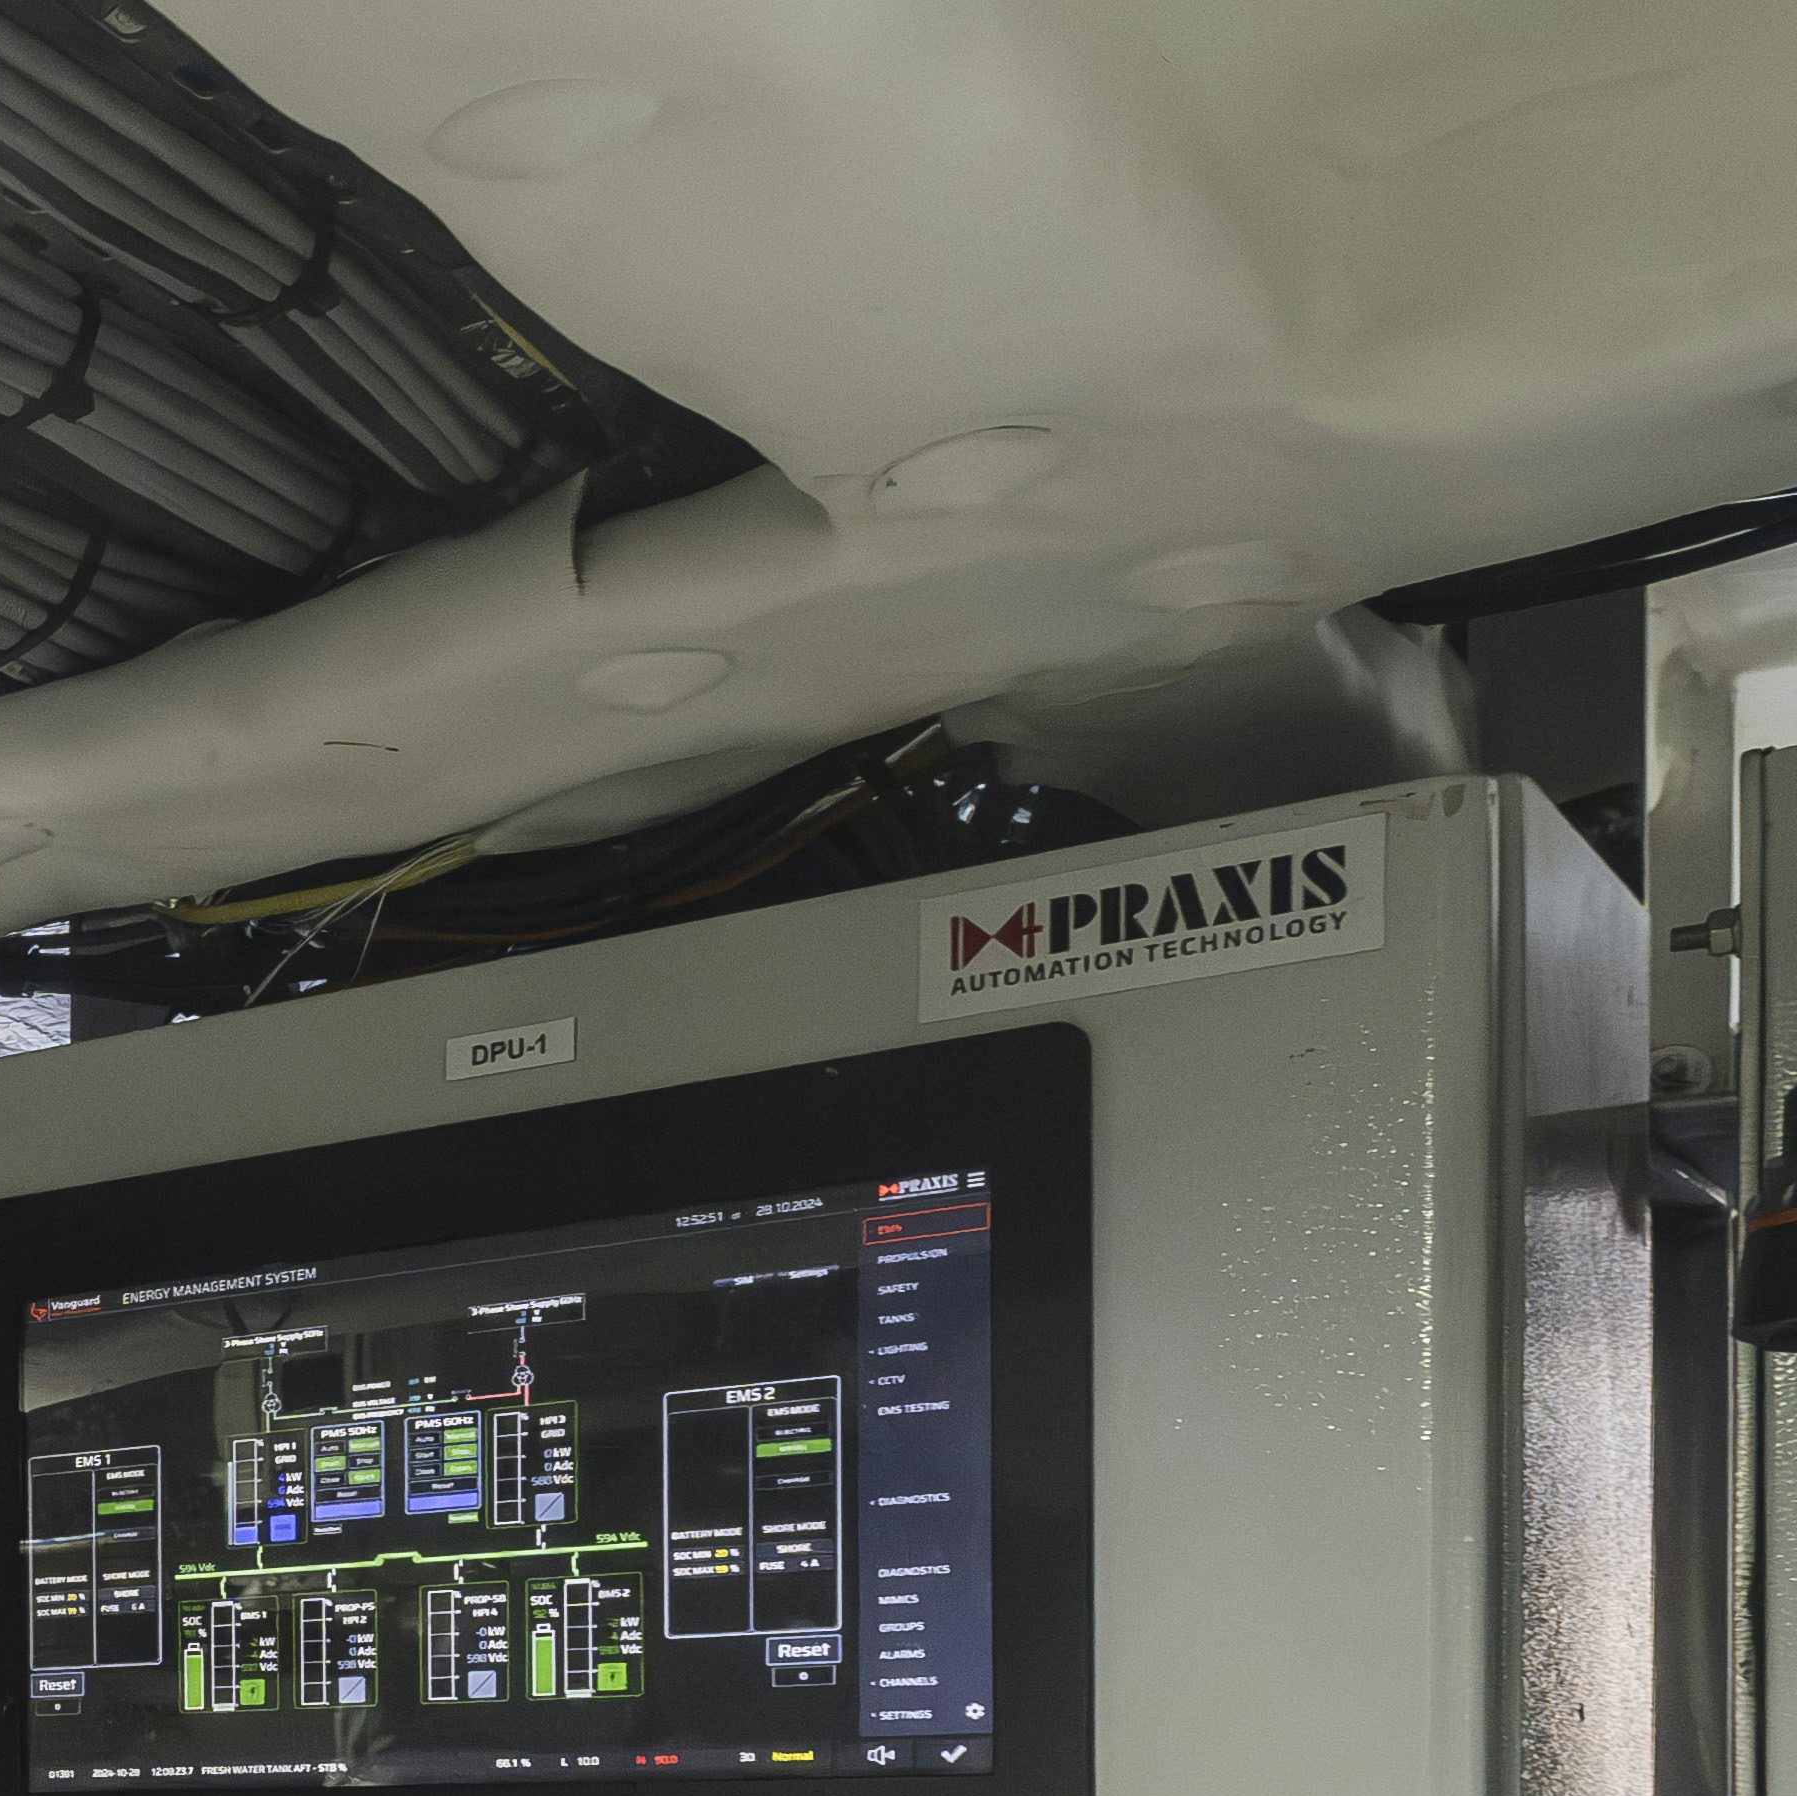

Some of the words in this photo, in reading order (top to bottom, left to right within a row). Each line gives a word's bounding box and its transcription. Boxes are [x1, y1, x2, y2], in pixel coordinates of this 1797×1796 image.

[1048, 845, 1347, 954] PRAXIS
[950, 948, 1133, 996] AUTOMATION
[1144, 911, 1348, 963] TECHNOLOGY
[472, 1033, 546, 1066] DPU-1
[898, 1174, 958, 1193] PRAXIS
[877, 1248, 948, 1264] PROPULSION
[122, 1288, 170, 1305] ENERGY
[173, 1275, 262, 1297] MANAGEMENT
[265, 1268, 317, 1286] SYSTEM
[877, 1282, 919, 1295] SAFETY
[51, 1295, 101, 1310] Vanguard
[878, 1313, 915, 1325] TANKS
[878, 1342, 928, 1355] LIGHTING
[878, 1375, 905, 1385] CCTV
[726, 1389, 761, 1404] EMS
[764, 1387, 776, 1400] 2
[904, 1401, 950, 1413] TESTING
[415, 1419, 442, 1430] PMS
[443, 1417, 474, 1426] 60Hz
[321, 1429, 346, 1438] PMS
[553, 1447, 571, 1457] kW
[75, 1455, 101, 1468] EMS
[105, 1454, 111, 1465] 1
[553, 1461, 574, 1471] Adc
[286, 1472, 302, 1481] kW
[553, 1475, 574, 1484] Vdc
[286, 1485, 304, 1495] Adc
[286, 1498, 304, 1508] Vdc
[878, 1493, 951, 1507] DIAGNOSTICS
[619, 1532, 641, 1542] Vdc
[198, 1563, 217, 1572] Vdc
[878, 1565, 951, 1578] DIAGNOSTICS
[530, 1595, 552, 1606] SOC
[878, 1594, 920, 1604] MIMICS
[182, 1616, 202, 1626] SOC
[620, 1617, 640, 1627] kW
[487, 1626, 506, 1636] kW
[878, 1622, 925, 1633] GROUPS
[259, 1637, 276, 1646] kW
[357, 1634, 374, 1643] kW
[620, 1631, 643, 1641] Adc
[487, 1640, 508, 1650] Adc
[620, 1644, 643, 1654] Vdc
[778, 1642, 831, 1658] Reset
[259, 1650, 278, 1659] Adc
[357, 1646, 376, 1656] Adc
[879, 1649, 926, 1660] ALARMS
[487, 1652, 508, 1663] Vdc
[259, 1663, 278, 1672] Vdc
[357, 1659, 376, 1669] Vdc
[39, 1679, 77, 1691] Reset
[879, 1676, 939, 1687] CHANNELS
[879, 1710, 933, 1720] SETTINGS
[772, 1750, 814, 1762] Normal
[201, 1766, 231, 1775] FRESH
[233, 1765, 266, 1774] WATER
[267, 1764, 292, 1773] TANK
[293, 1764, 311, 1773] AFT
[318, 1763, 337, 1772] STB
